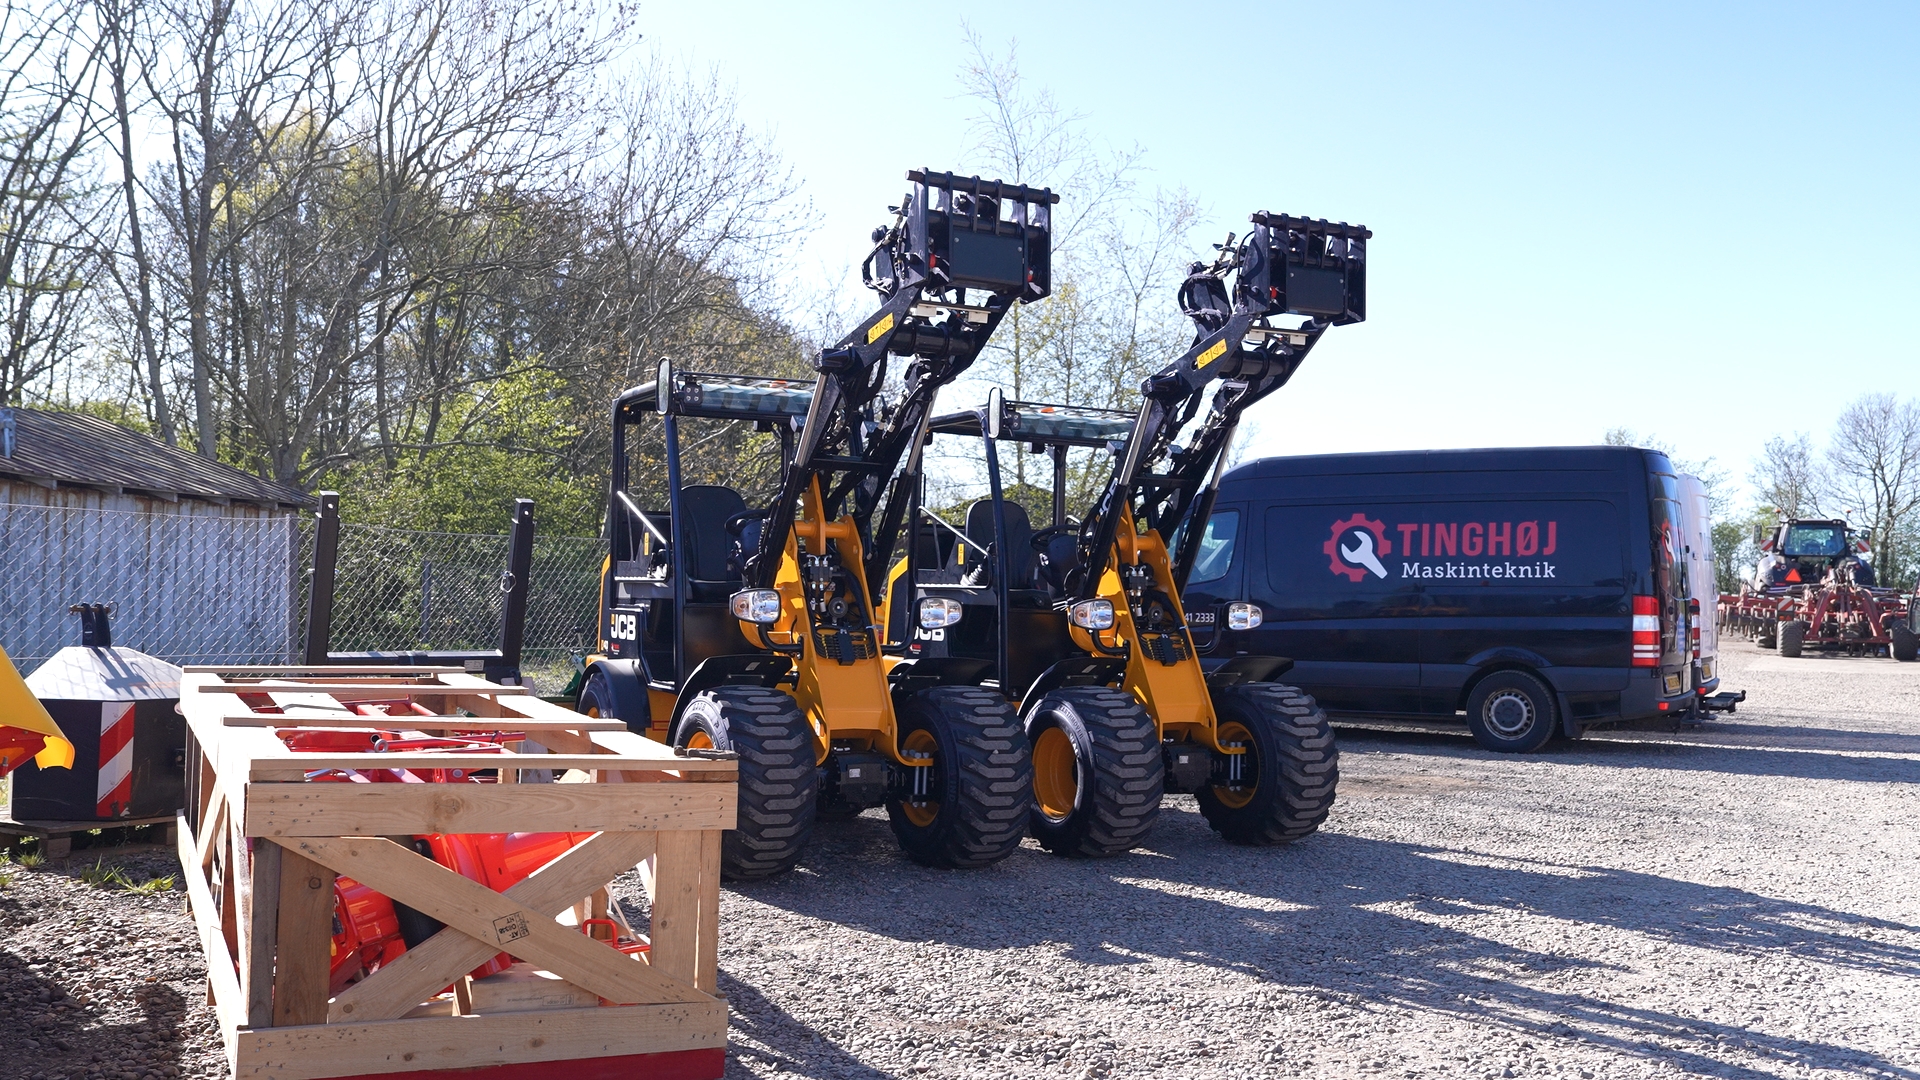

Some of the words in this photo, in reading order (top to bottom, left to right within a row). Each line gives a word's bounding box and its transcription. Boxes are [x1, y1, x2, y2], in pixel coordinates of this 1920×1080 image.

[1396, 520, 1557, 557] TINGHØJ
[1401, 562, 1556, 578] Maskinteknik
[611, 614, 636, 641] JCB
